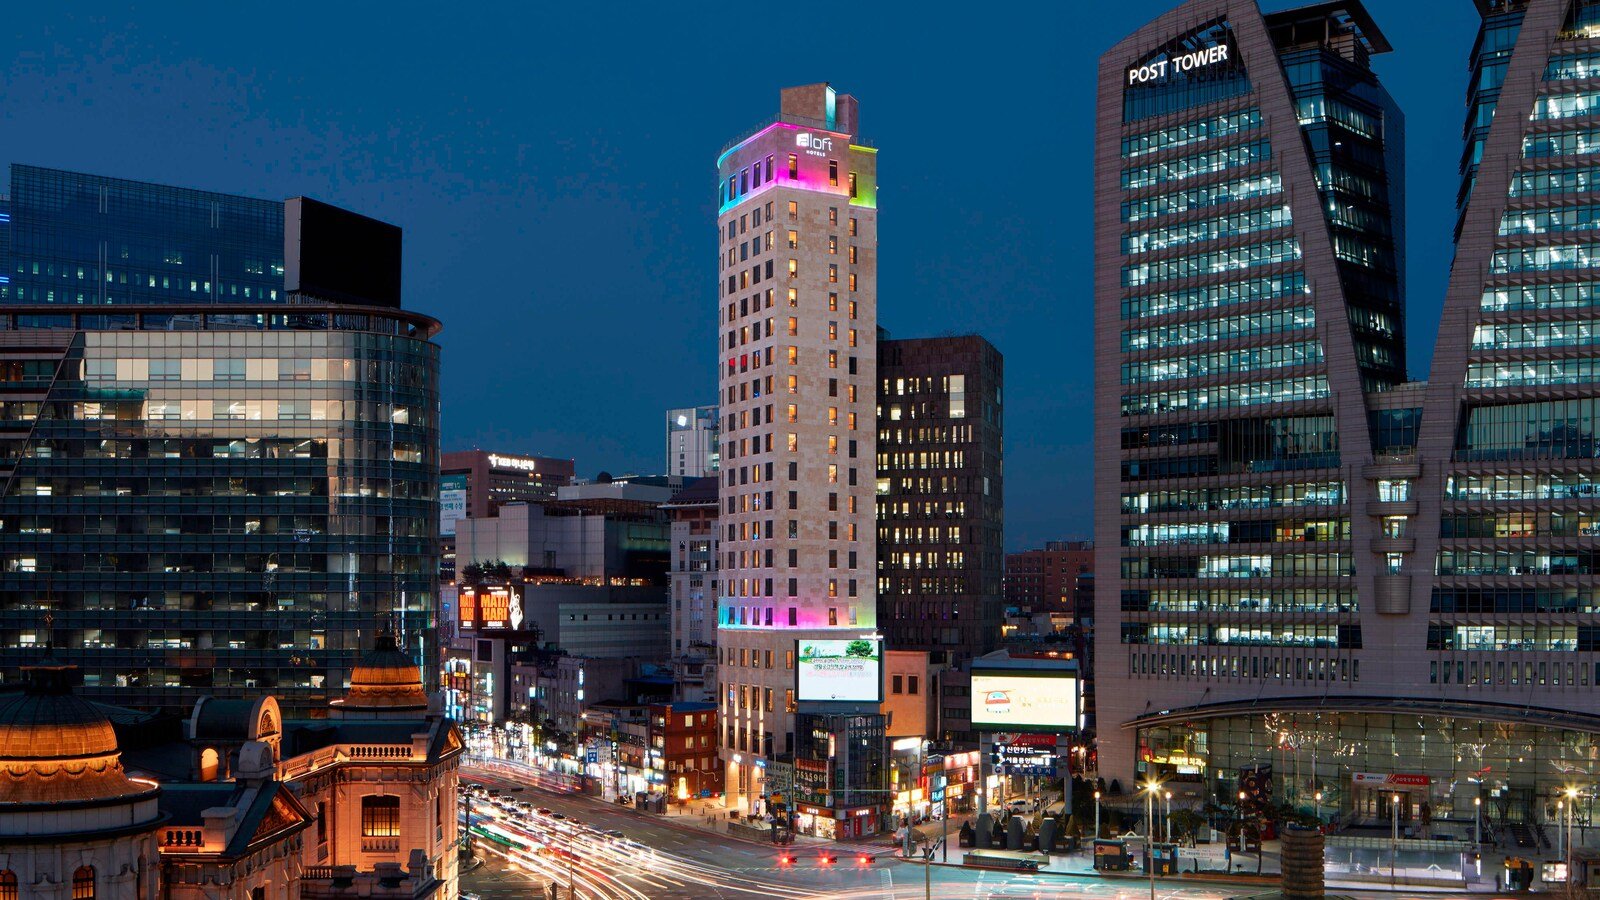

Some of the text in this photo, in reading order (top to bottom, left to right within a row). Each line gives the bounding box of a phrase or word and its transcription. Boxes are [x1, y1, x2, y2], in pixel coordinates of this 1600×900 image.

[1129, 44, 1228, 85] POST TOWER
[480, 594, 509, 608] MATA
[482, 607, 508, 621] HARI
